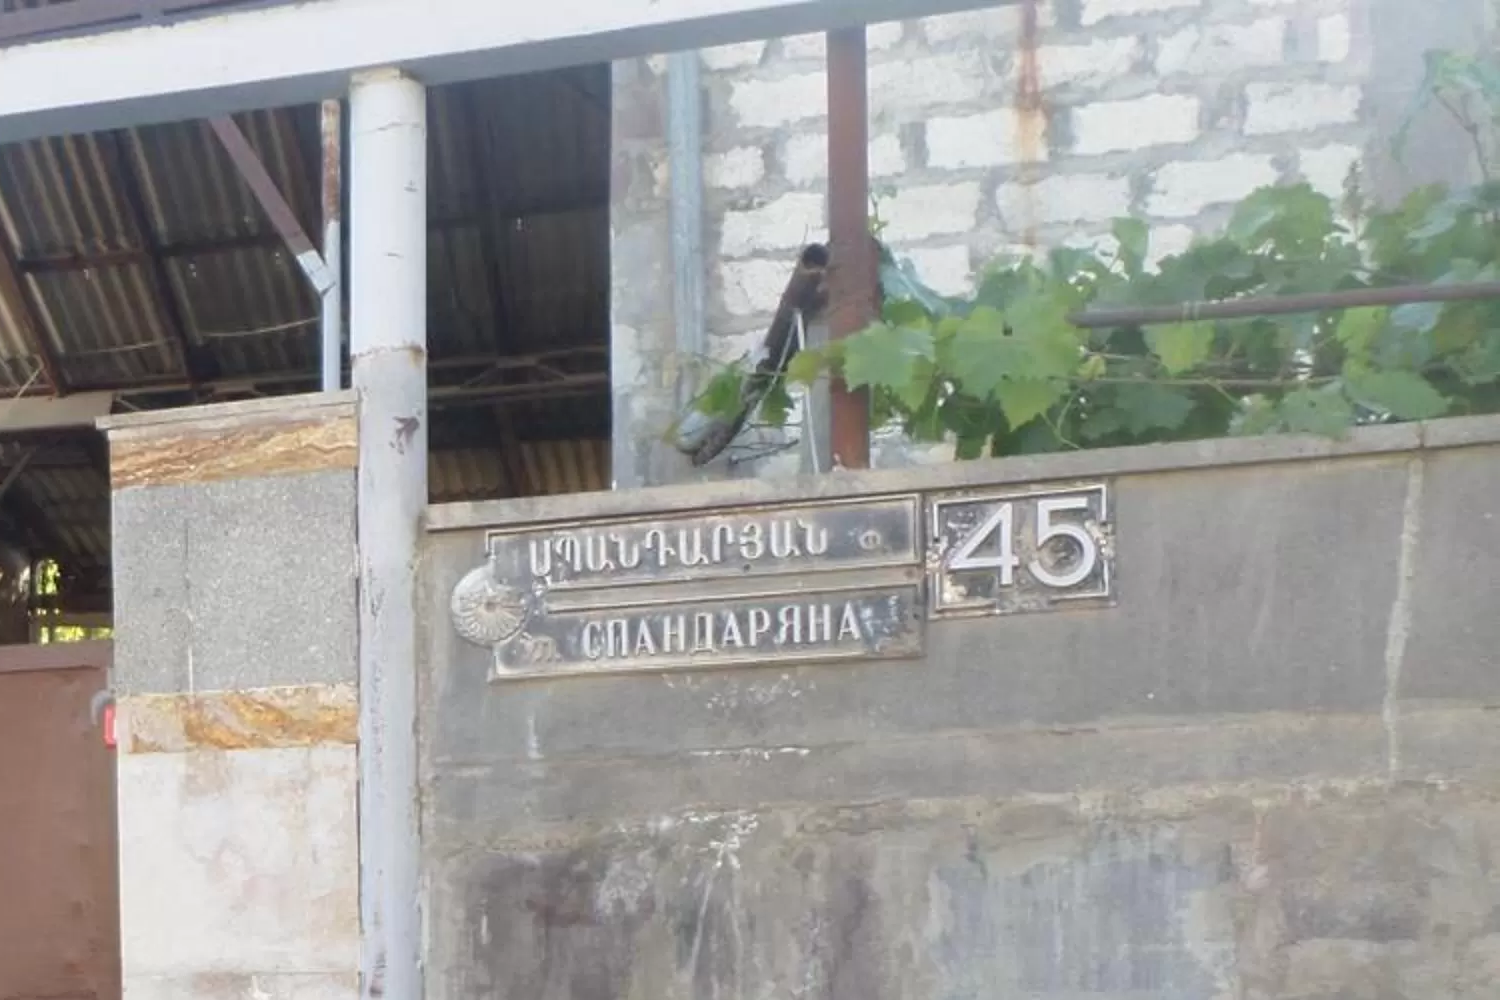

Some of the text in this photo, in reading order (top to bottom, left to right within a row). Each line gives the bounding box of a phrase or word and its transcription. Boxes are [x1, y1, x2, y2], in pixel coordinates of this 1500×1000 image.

[529, 517, 829, 577] ՍՊԱՆԴԱՐՅԱՆ
[948, 496, 1096, 588] 45
[582, 601, 862, 660] СПАНДАРЯНА
